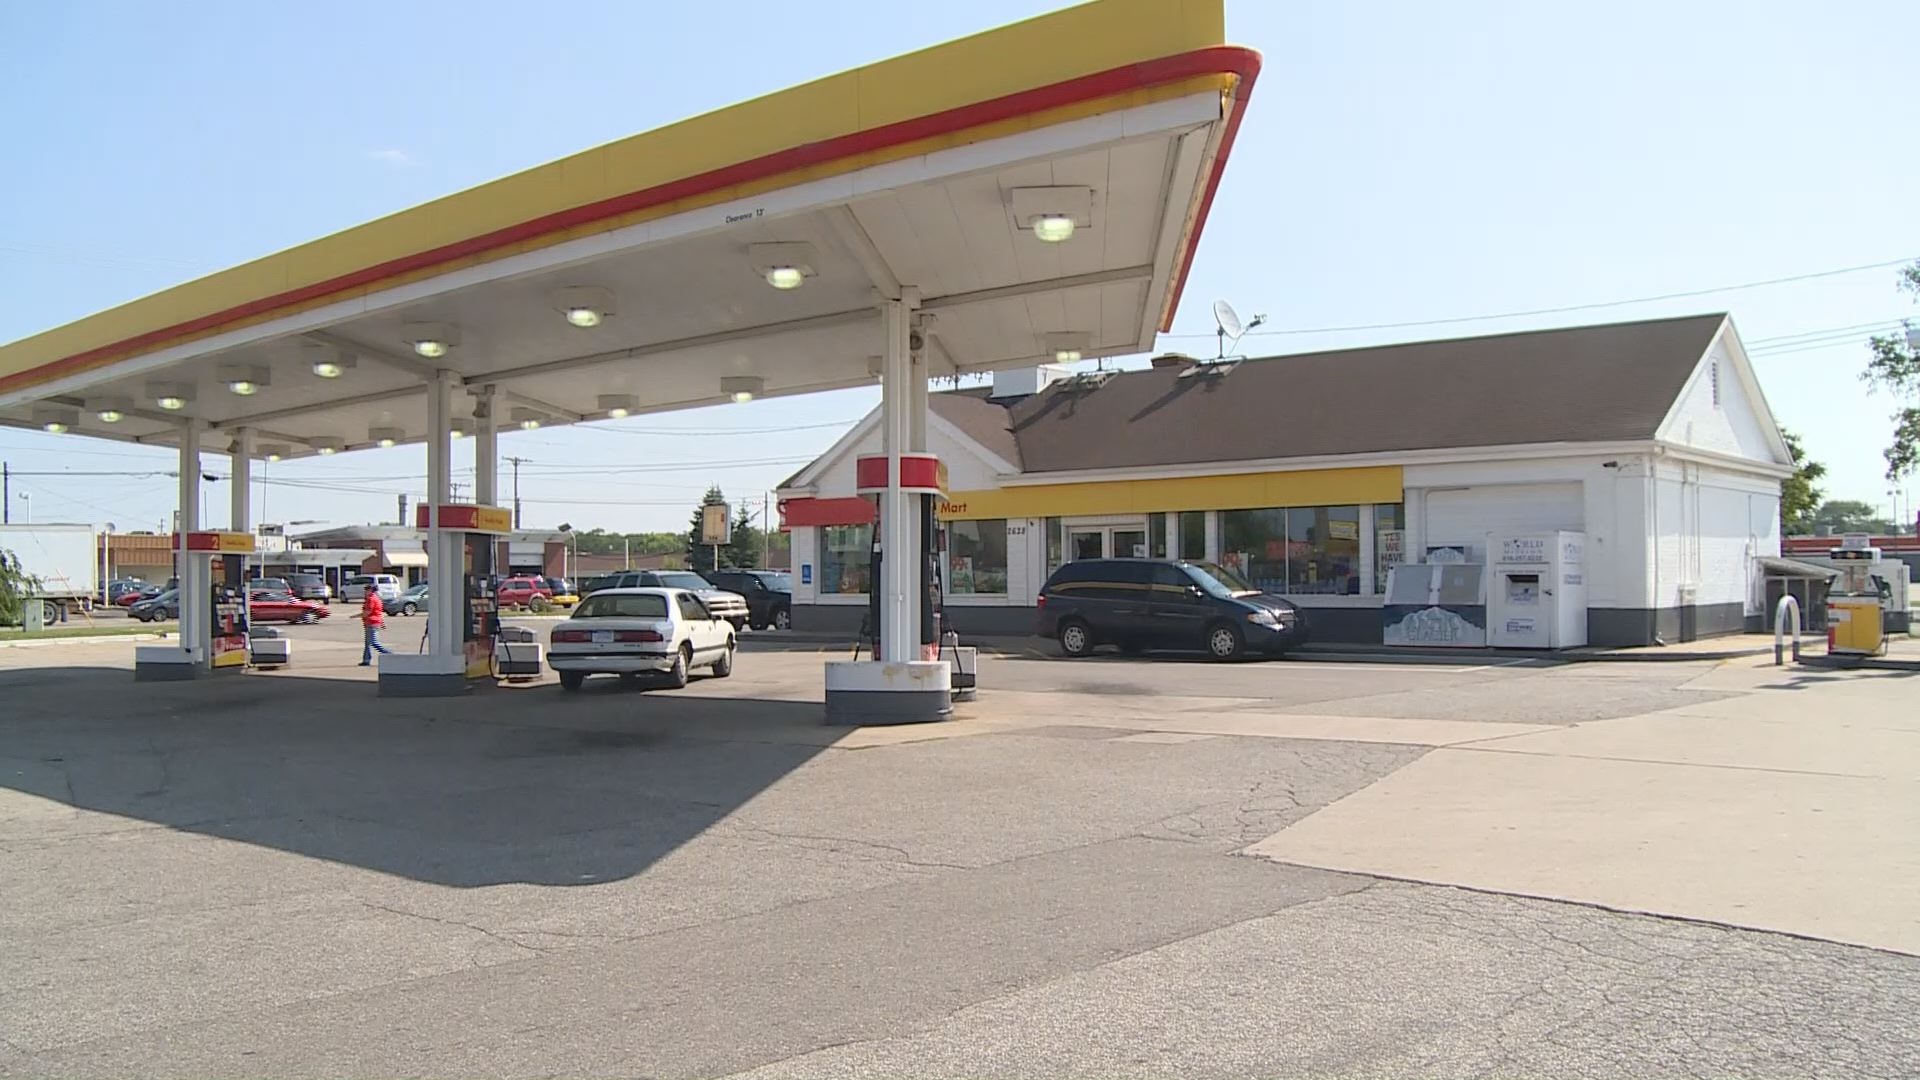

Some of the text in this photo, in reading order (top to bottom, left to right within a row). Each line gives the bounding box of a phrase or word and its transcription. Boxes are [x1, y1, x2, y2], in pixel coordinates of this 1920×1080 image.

[725, 213, 752, 224] Clearance
[940, 502, 967, 513] Mart
[1386, 543, 1400, 552] WE
[1381, 553, 1404, 562] HAVE
